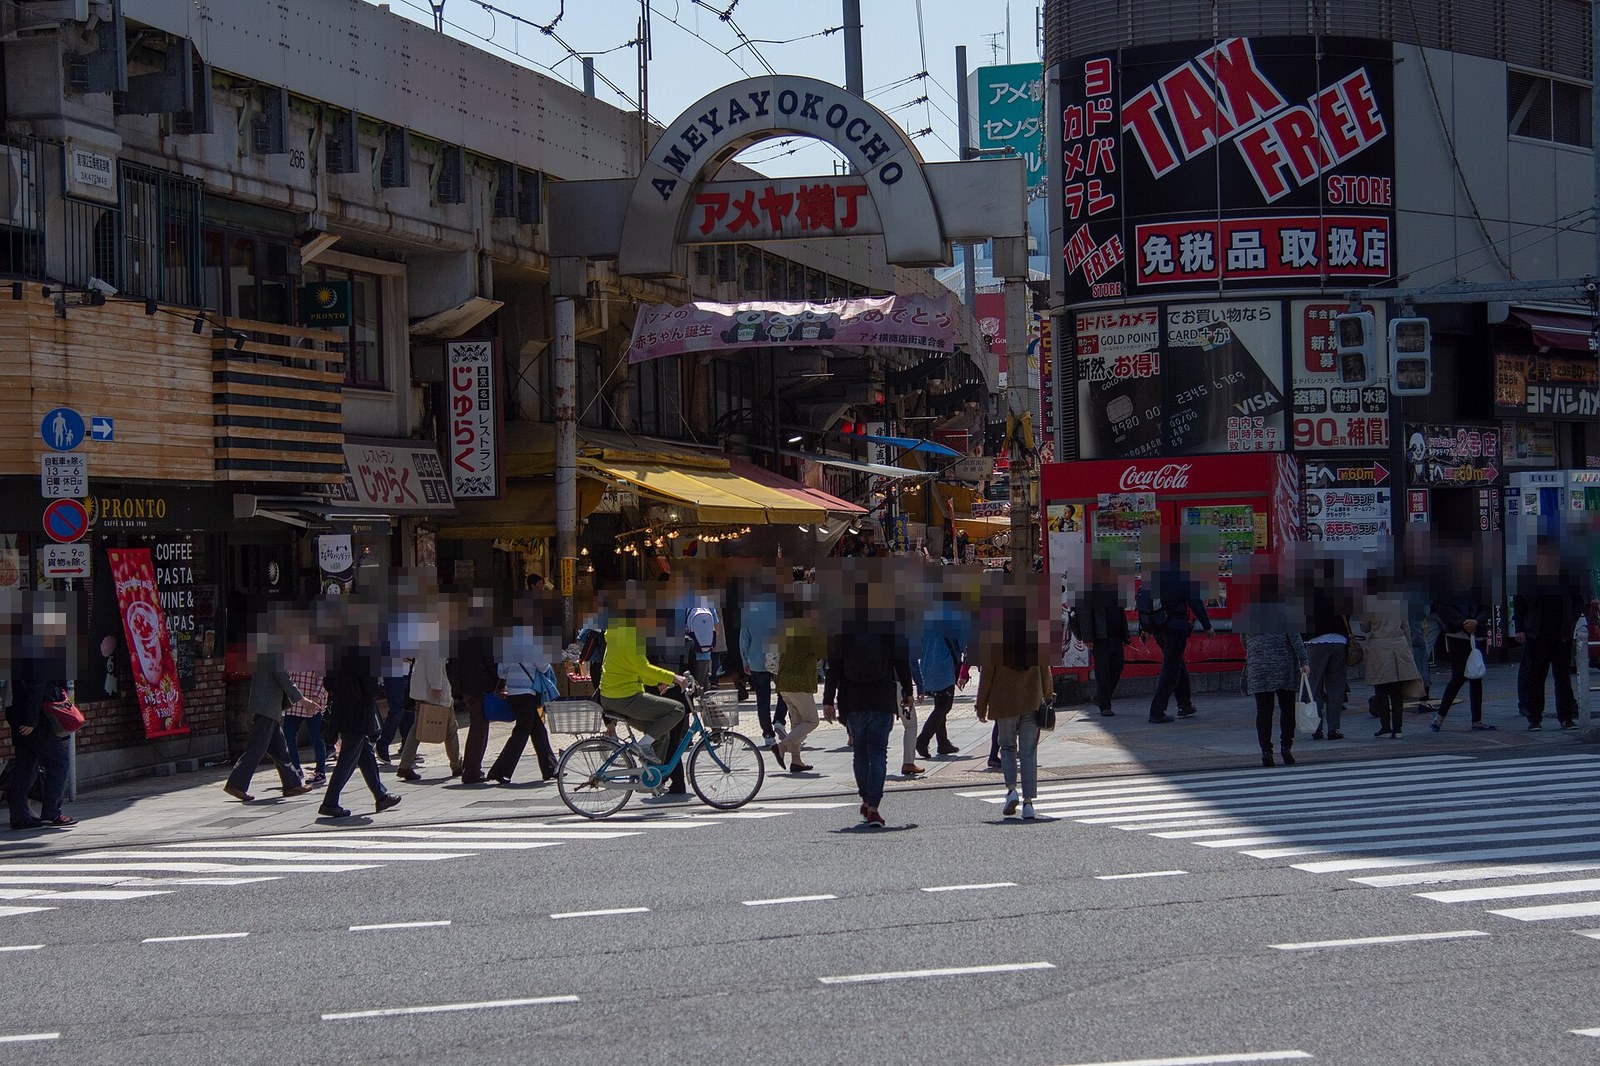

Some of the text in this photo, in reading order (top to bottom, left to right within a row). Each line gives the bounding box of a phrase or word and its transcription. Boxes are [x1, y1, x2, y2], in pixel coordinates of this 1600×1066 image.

[1121, 36, 1289, 181] TAX
[650, 89, 904, 201] AMEYAYOKOCHO
[1085, 57, 1116, 216] ヨドバシ
[1233, 66, 1387, 205] FREE
[289, 149, 305, 169] 266
[1063, 104, 1084, 220] カメラ
[1327, 175, 1392, 207] STORE
[694, 183, 868, 235] アメヤ横丁
[1063, 222, 1098, 276] TAX
[1143, 227, 1387, 276] 免税品取扱店
[1081, 233, 1125, 288] FREE
[1092, 281, 1122, 299] STORE
[310, 312, 345, 320] PRONTO
[1077, 307, 1272, 332] ヨドバシカメラ でお買い物なら
[635, 324, 713, 349] 赤ちゃん誕生
[859, 332, 946, 348] アメ横商店街連合会
[1100, 334, 1125, 346] GOLD
[1127, 331, 1158, 344] POINT
[1168, 329, 1198, 341] CARD
[1176, 371, 1246, 405] 2345 6789
[1293, 389, 1326, 405] 盗難
[1331, 389, 1359, 404] 破損
[1363, 389, 1386, 404] 水没
[1235, 391, 1280, 416] VISA
[1526, 386, 1600, 415] ヨドバシカメ
[452, 366, 475, 473] じゅらく
[1111, 415, 1140, 436] 4980
[1227, 416, 1264, 429] 店内で
[479, 413, 491, 472] レストラン
[1227, 428, 1277, 440] 即時発行
[1456, 428, 1497, 457] 2号店
[44, 456, 83, 466] 自転車を除く
[362, 449, 395, 463] レストラン
[358, 464, 419, 504] じゅらく
[101, 498, 166, 519] PRONTO
[1325, 492, 1375, 507] ゲームランド
[1324, 521, 1378, 535] おもちゃランド
[156, 543, 193, 560] COFFEE
[47, 558, 86, 567] 貨物を除く
[156, 566, 194, 585] PASTA
[159, 590, 194, 609] WINE &
[165, 614, 195, 632] APAS
